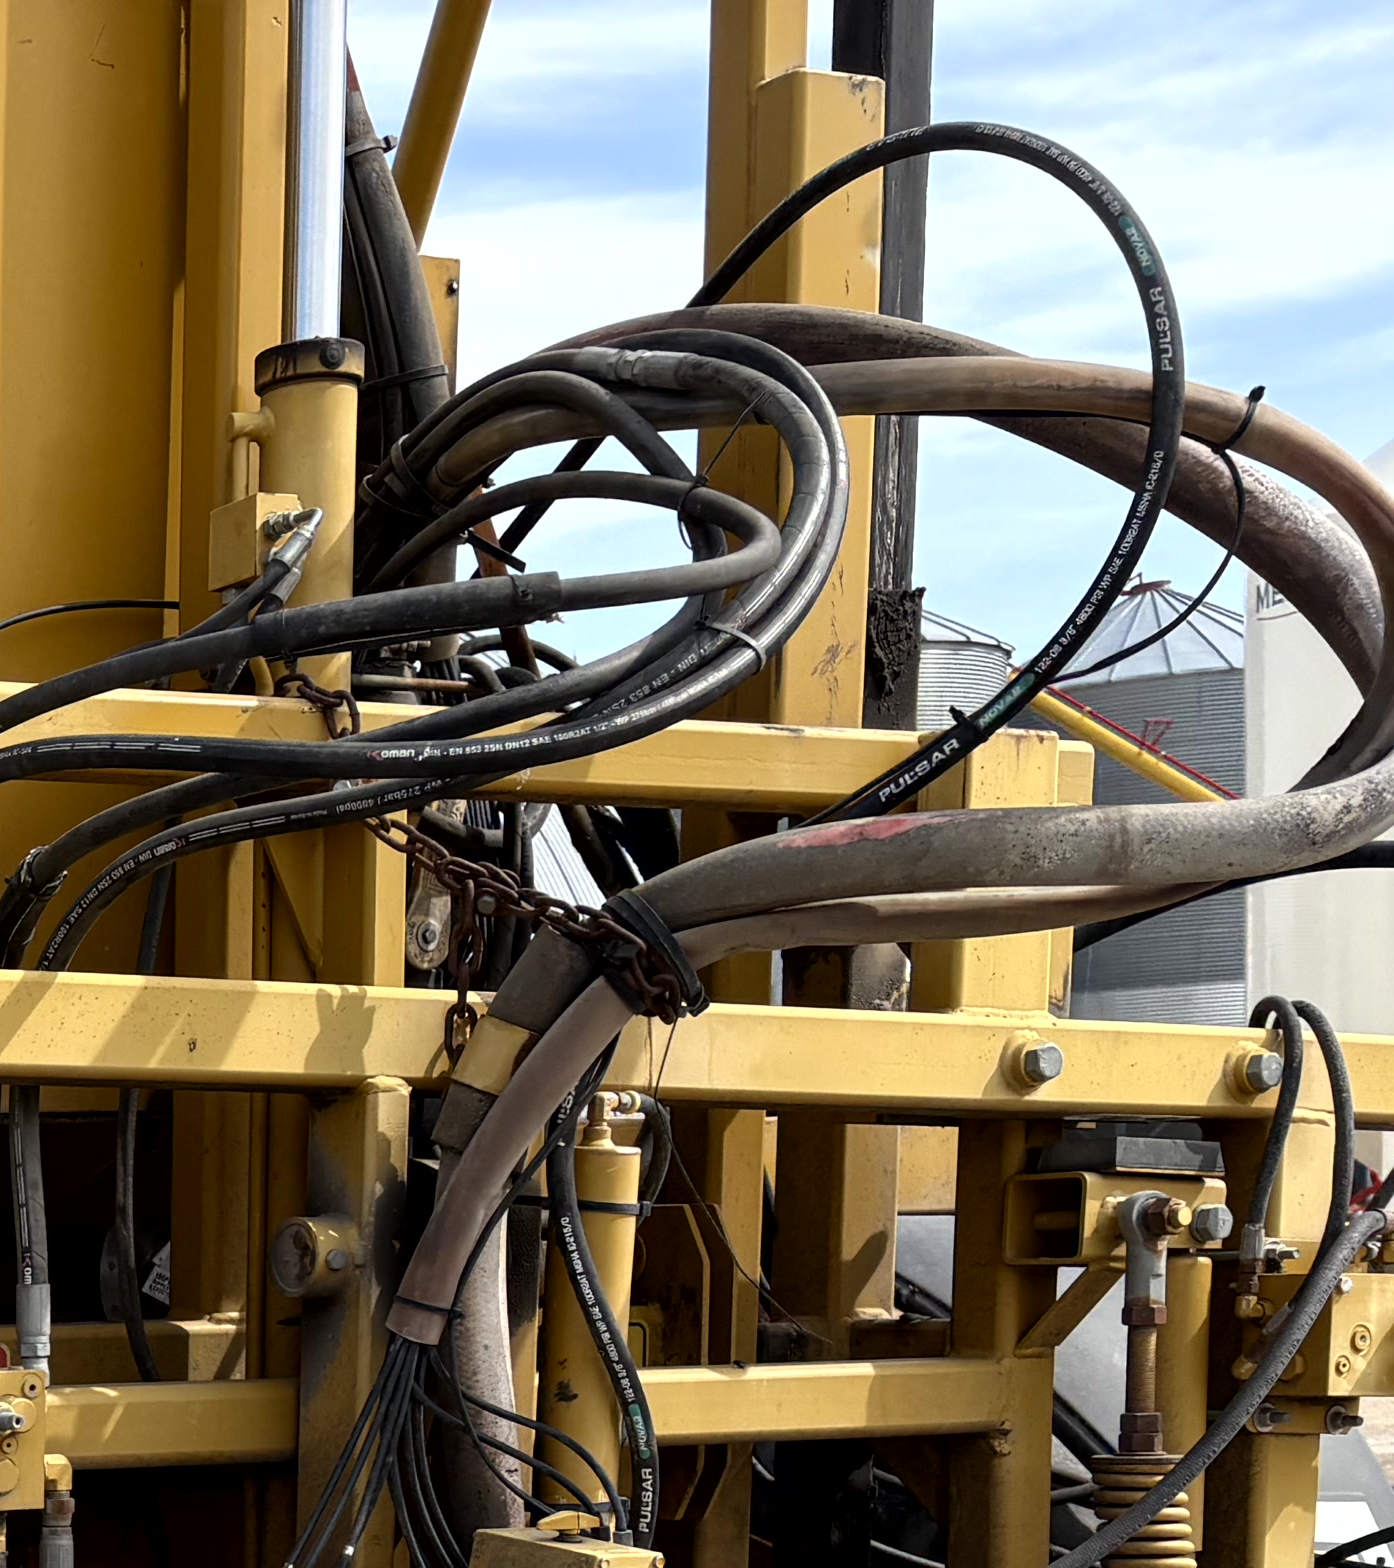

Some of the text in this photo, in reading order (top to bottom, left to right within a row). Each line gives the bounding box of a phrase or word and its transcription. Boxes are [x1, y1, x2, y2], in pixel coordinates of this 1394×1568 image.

[1124, 225, 1152, 267] NOVAR
[1147, 285, 1173, 372] PULSAR
[675, 651, 698, 672] DIN
[650, 671, 670, 689] EN
[876, 736, 962, 803] PULSAR
[975, 682, 1024, 730] NOVAR
[1097, 572, 1114, 592] WP
[627, 682, 652, 704] 853
[448, 746, 464, 756] EN
[504, 738, 530, 750] DN12
[530, 734, 551, 746] SAE
[65, 903, 83, 924] SAE
[594, 1317, 608, 1333] WP
[604, 1341, 621, 1363] 4800
[619, 1376, 637, 1402] 122-08
[637, 1466, 653, 1533] PULSAR
